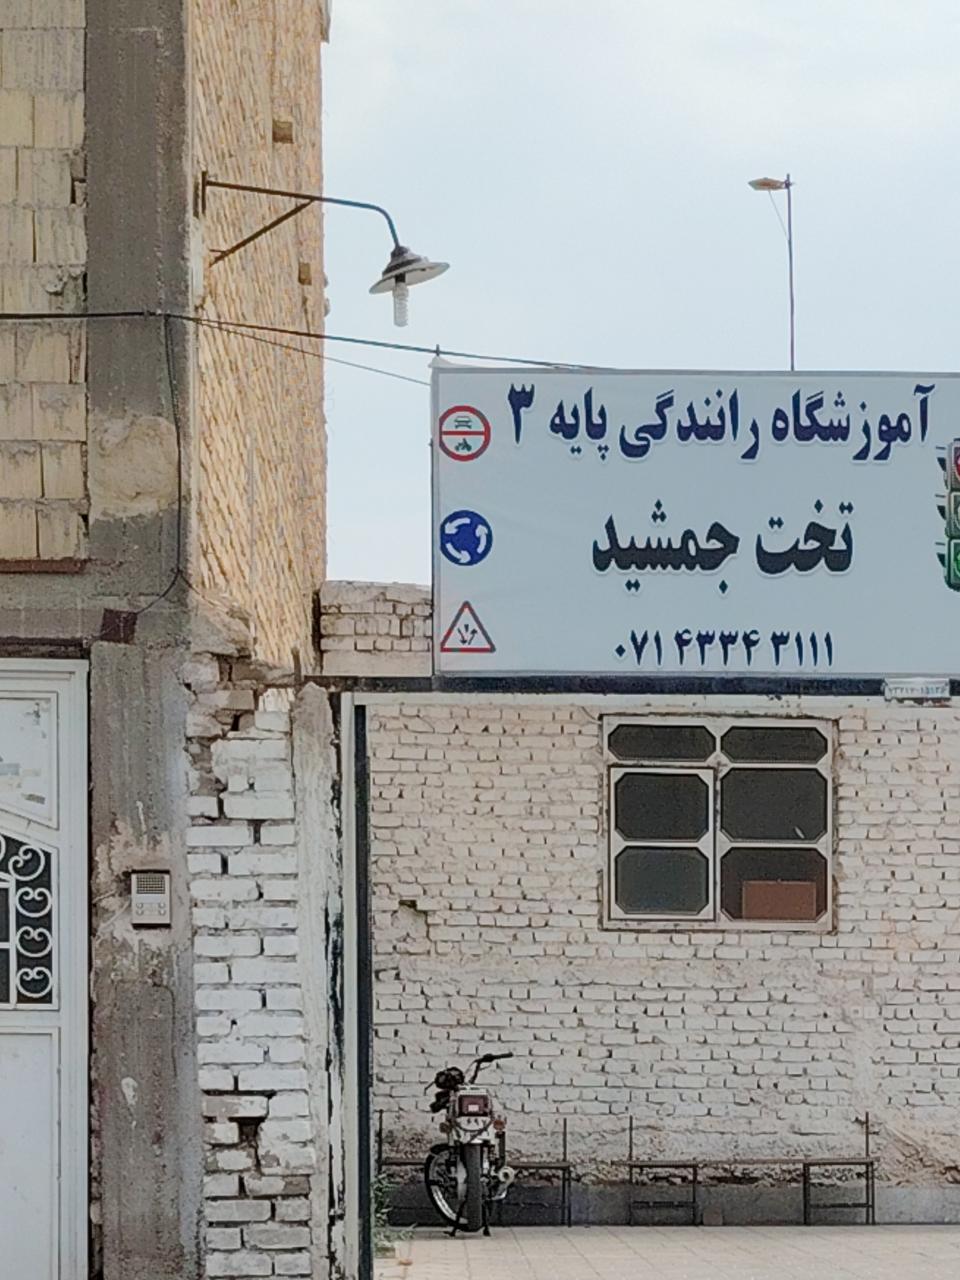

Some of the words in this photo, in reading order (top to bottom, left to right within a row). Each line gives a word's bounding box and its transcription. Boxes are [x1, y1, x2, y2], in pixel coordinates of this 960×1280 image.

[507, 383, 535, 443] ۳
[549, 387, 610, 461] پایه
[620, 389, 760, 460] رانندگی
[771, 384, 936, 461] آموزشگاه
[592, 500, 741, 594] جمشید
[756, 500, 854, 575] تخت
